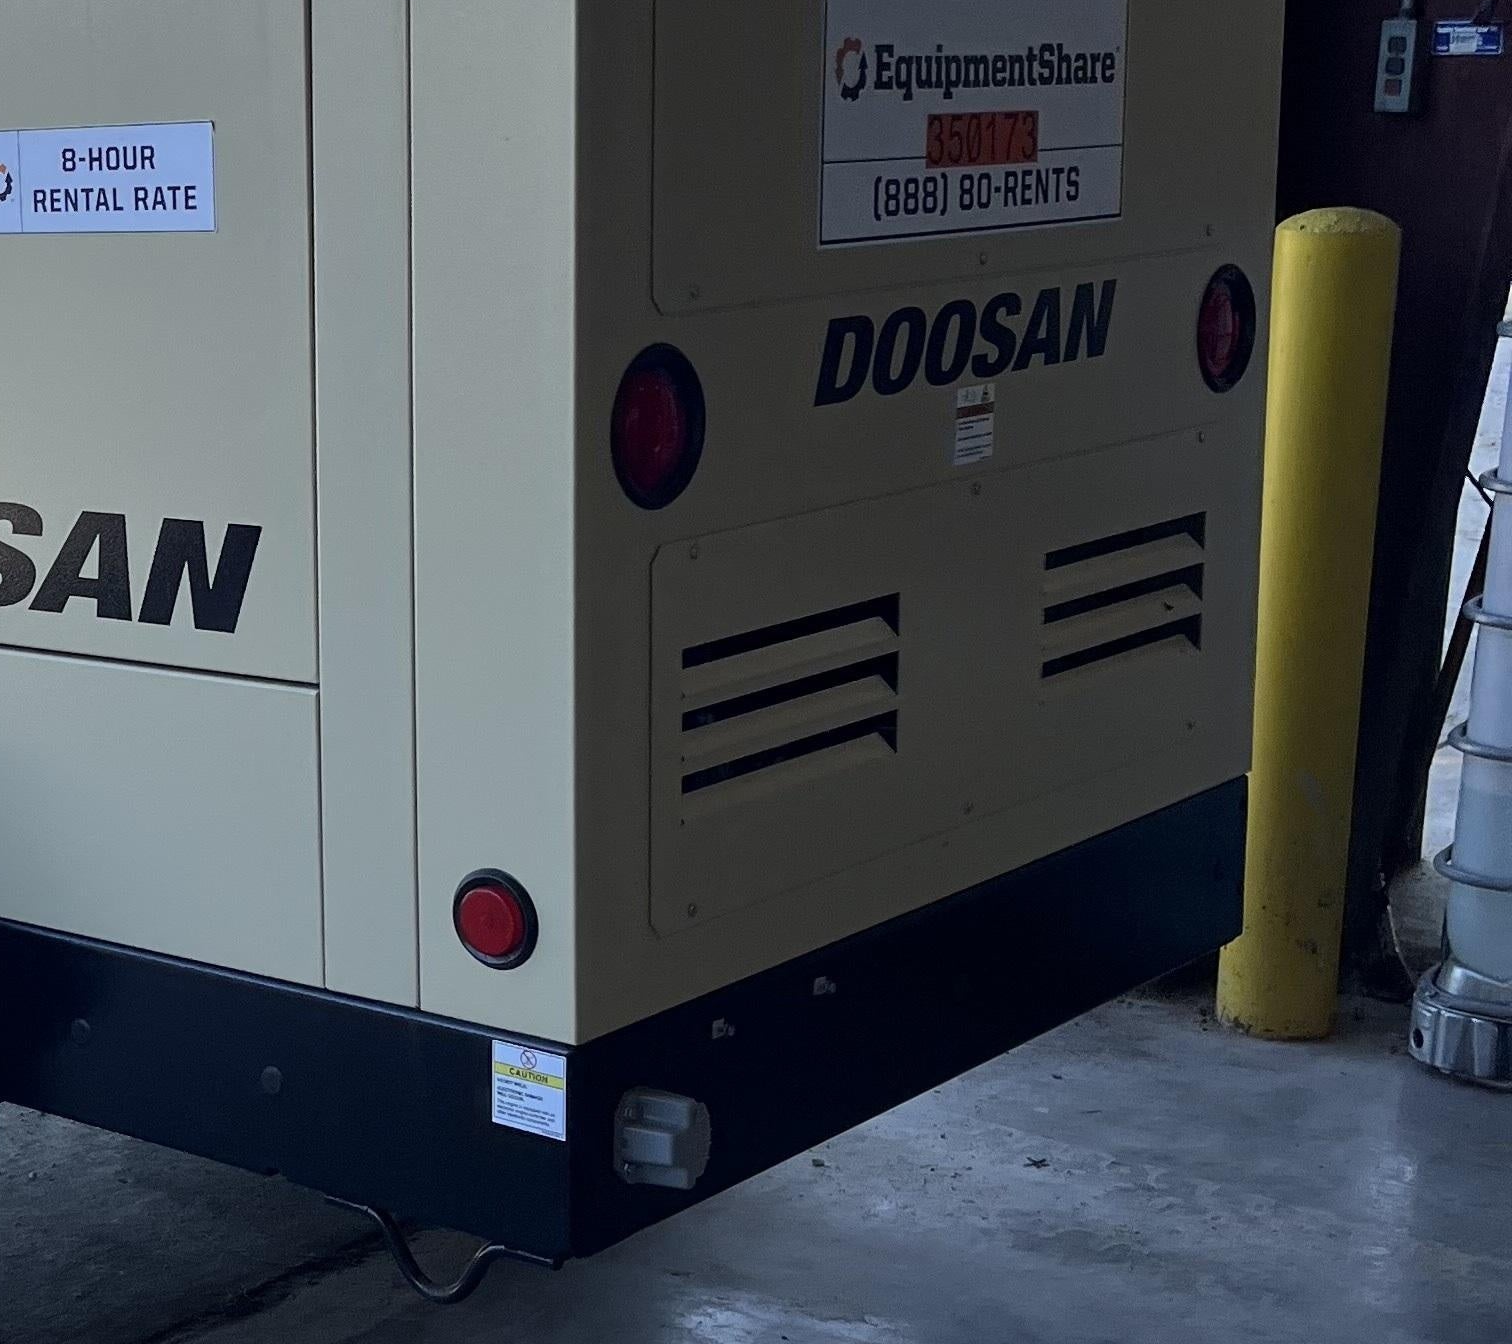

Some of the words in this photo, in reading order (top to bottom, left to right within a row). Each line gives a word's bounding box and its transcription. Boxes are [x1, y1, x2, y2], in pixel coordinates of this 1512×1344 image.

[873, 43, 1116, 101] EquipmentShare
[61, 145, 156, 172] 8-HOUR
[928, 111, 1038, 166] 350173
[33, 187, 124, 213] RENTAL
[134, 185, 198, 211] RATE
[874, 173, 949, 222] (888)
[959, 165, 1080, 212] 80-RENTS
[814, 279, 1117, 407] DOOSAN
[509, 1067, 548, 1084] CAUTION
